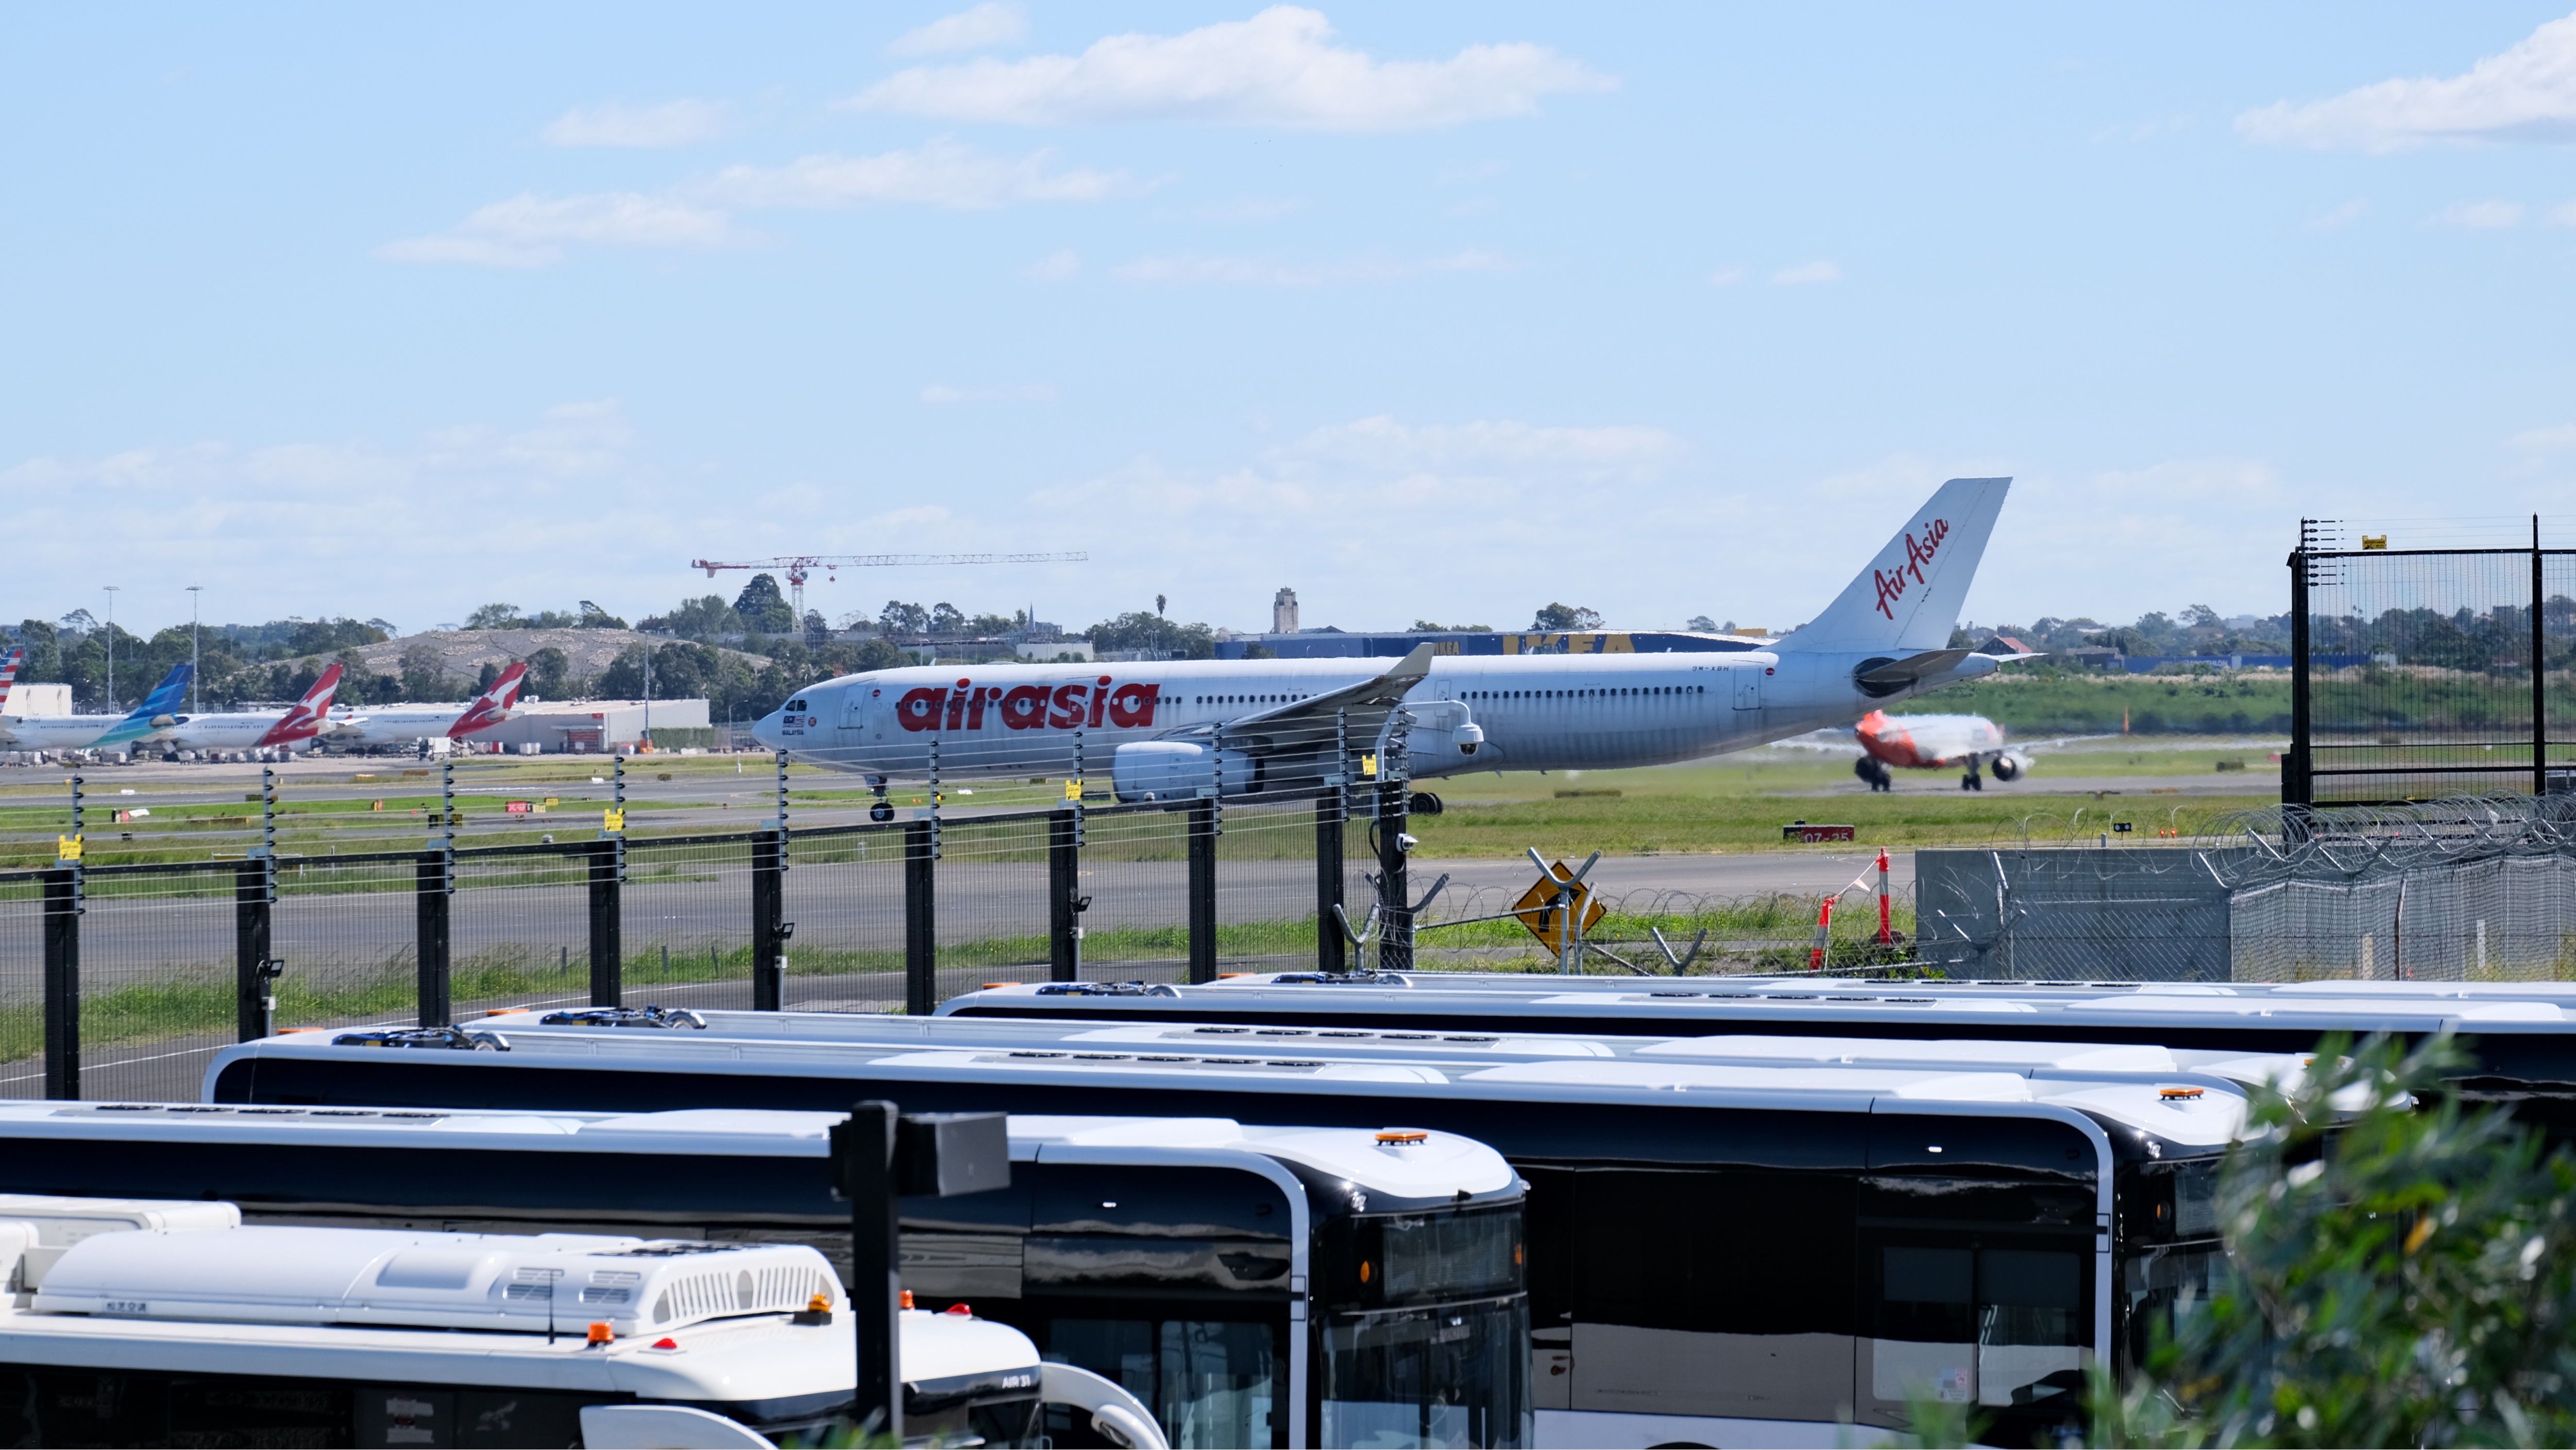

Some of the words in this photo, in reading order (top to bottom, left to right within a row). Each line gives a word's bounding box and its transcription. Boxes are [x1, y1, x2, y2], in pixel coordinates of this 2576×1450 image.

[1435, 641, 1460, 655] IKEA
[1503, 634, 1635, 654] IKEA
[897, 675, 1161, 732] airasia
[1805, 832, 1850, 843] 07-25
[1002, 1376, 1020, 1389] AIR
